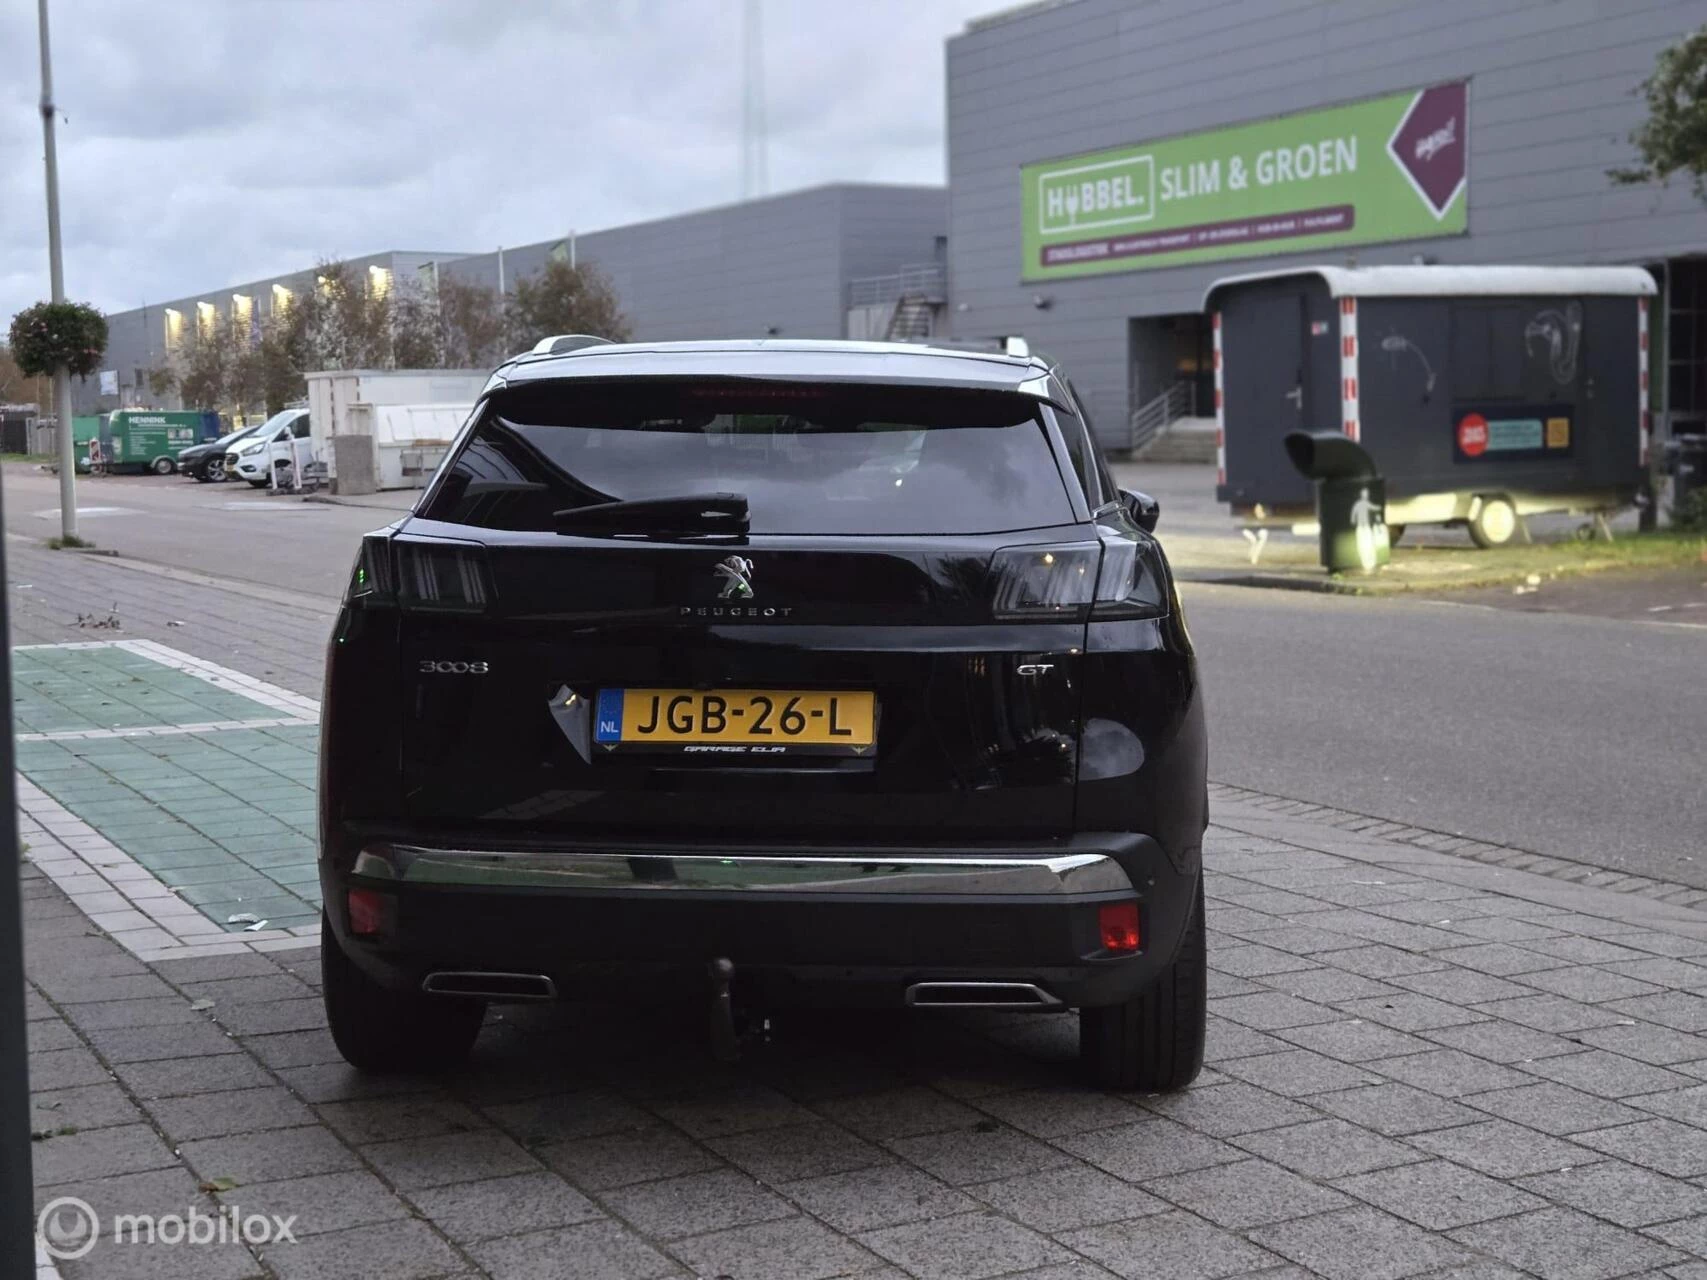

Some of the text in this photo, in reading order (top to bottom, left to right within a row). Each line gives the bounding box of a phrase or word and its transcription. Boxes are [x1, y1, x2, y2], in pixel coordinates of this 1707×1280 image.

[1160, 136, 1358, 201] SLIM & GROEN
[680, 606, 793, 617] PEUGEOT
[419, 660, 489, 674] 3008
[1017, 664, 1054, 675] GT
[637, 696, 852, 736] JGB-26-L
[600, 720, 619, 734] NL
[684, 745, 746, 753] GARAGE
